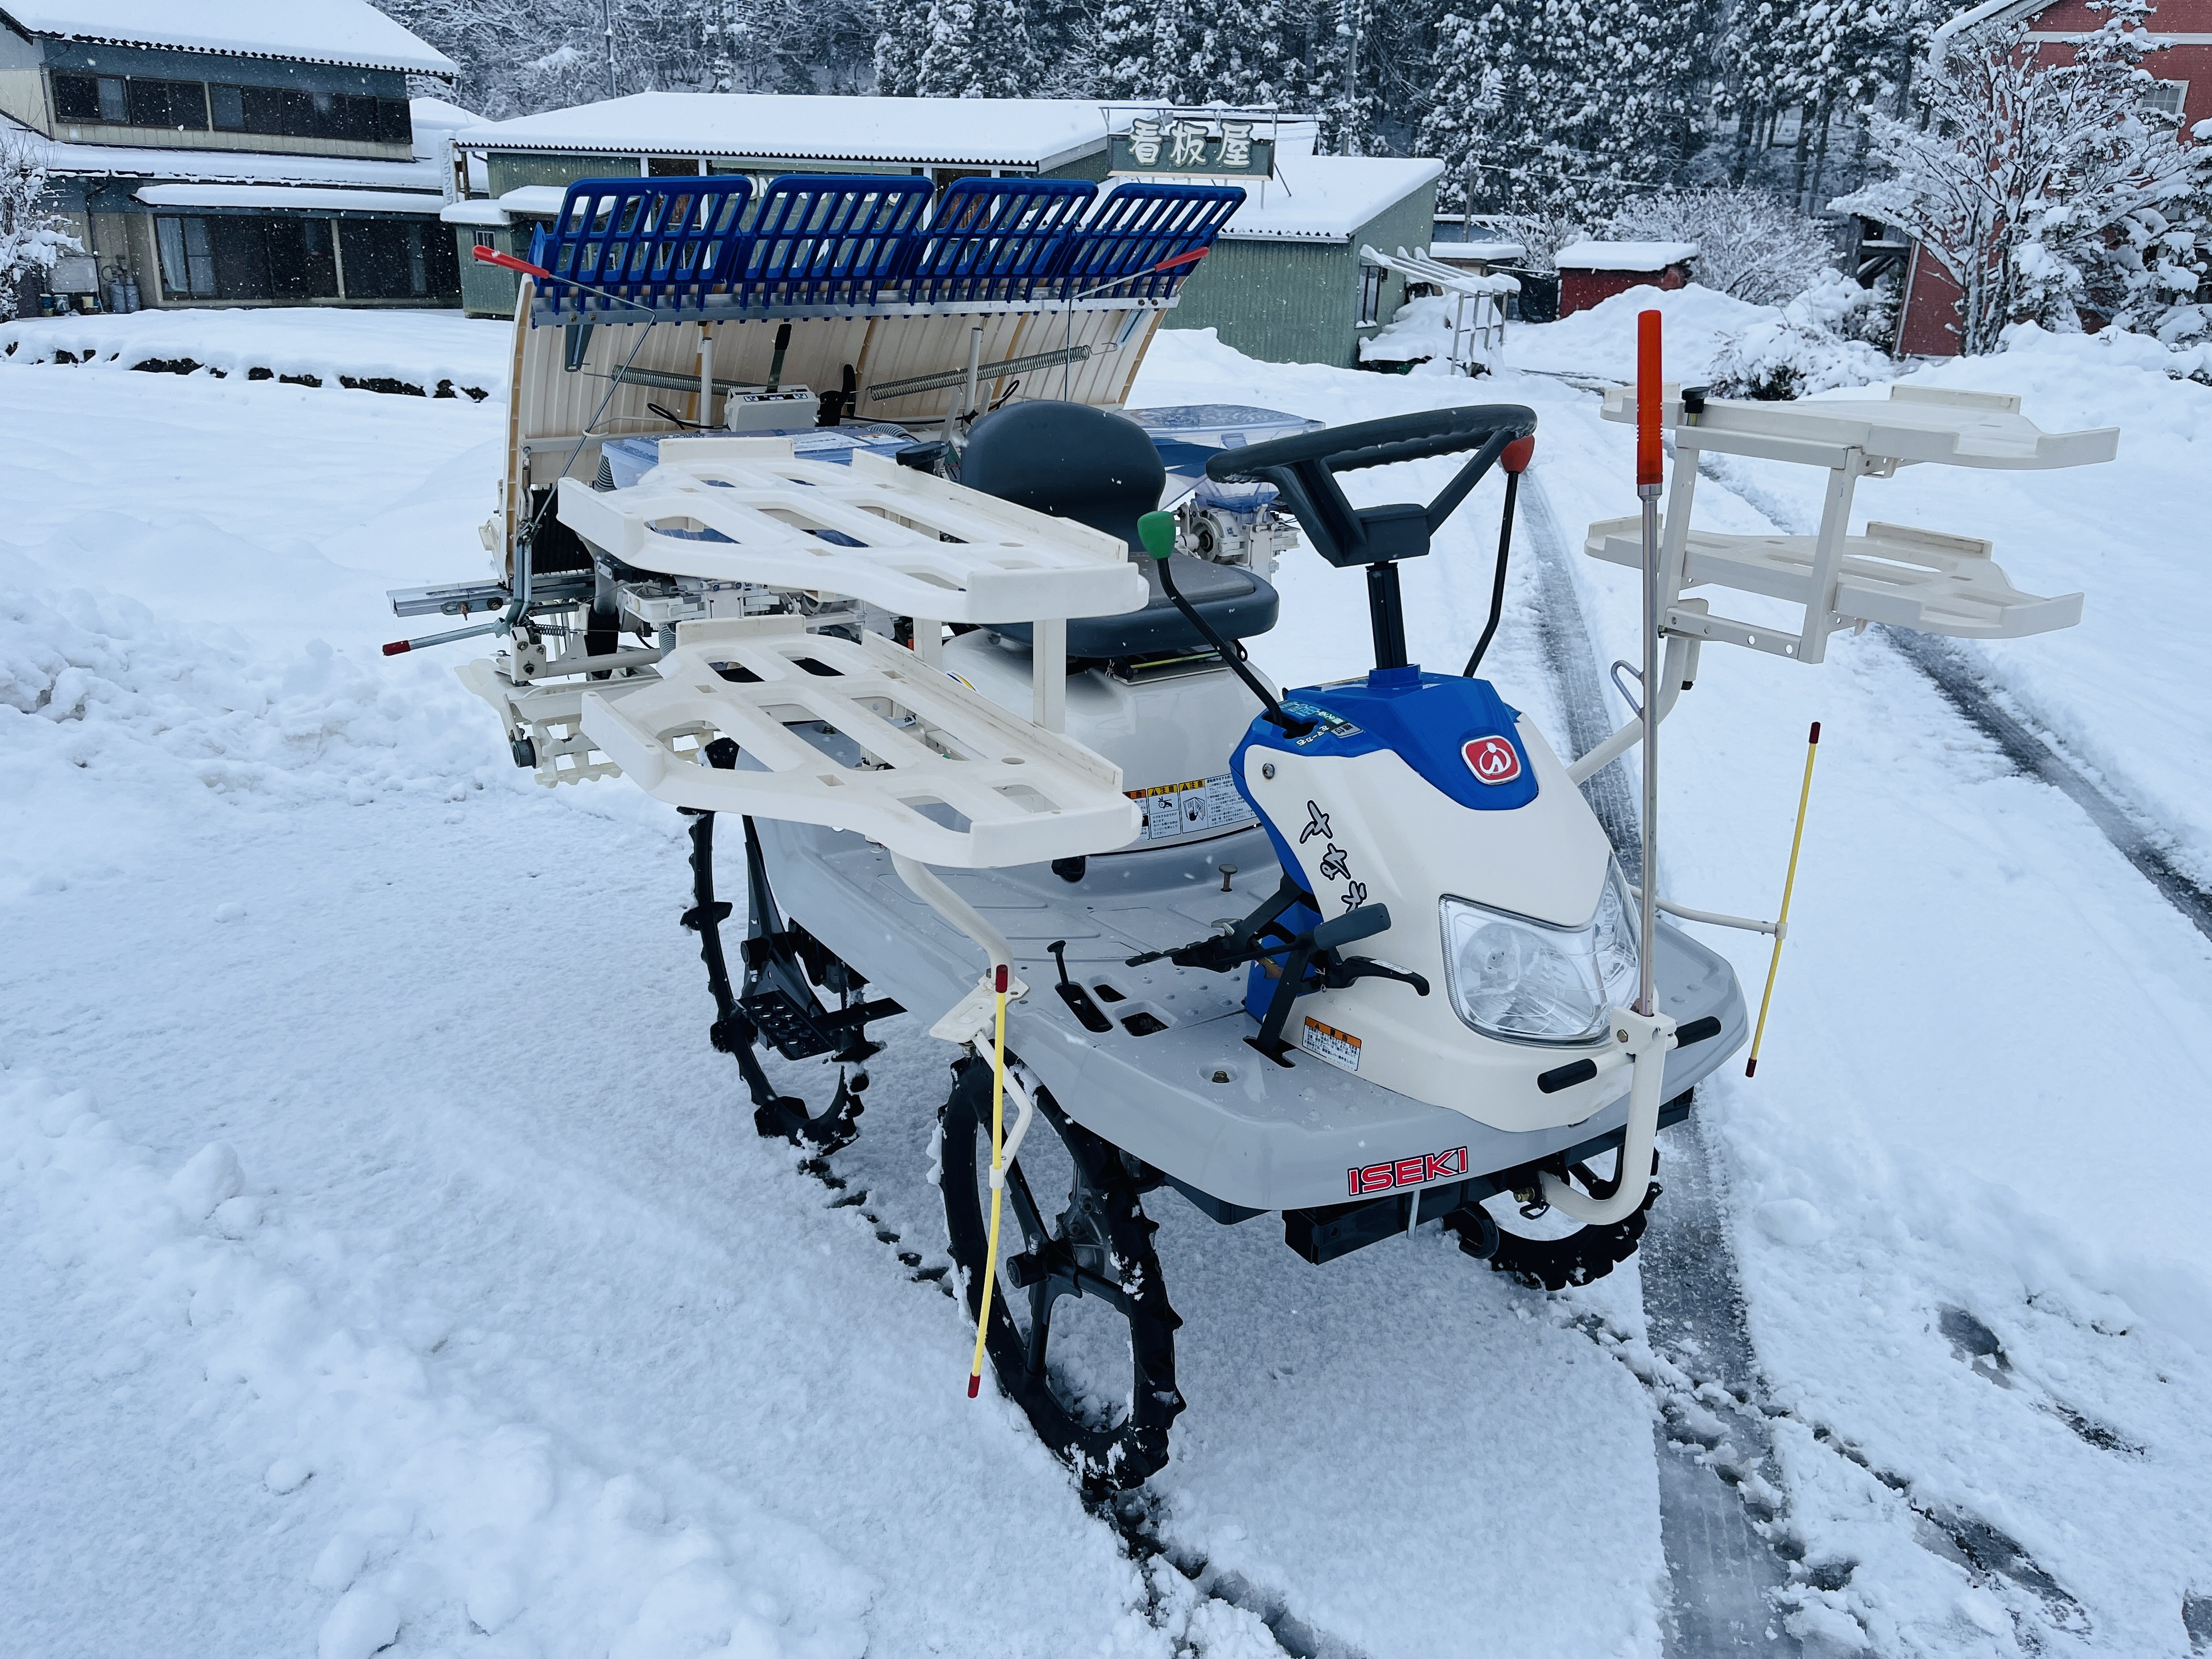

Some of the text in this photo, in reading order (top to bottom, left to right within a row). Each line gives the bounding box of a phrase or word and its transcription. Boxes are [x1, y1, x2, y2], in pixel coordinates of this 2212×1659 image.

[1129, 120, 1251, 166] 看板屋
[1347, 1146, 1469, 1197] ISEKI
